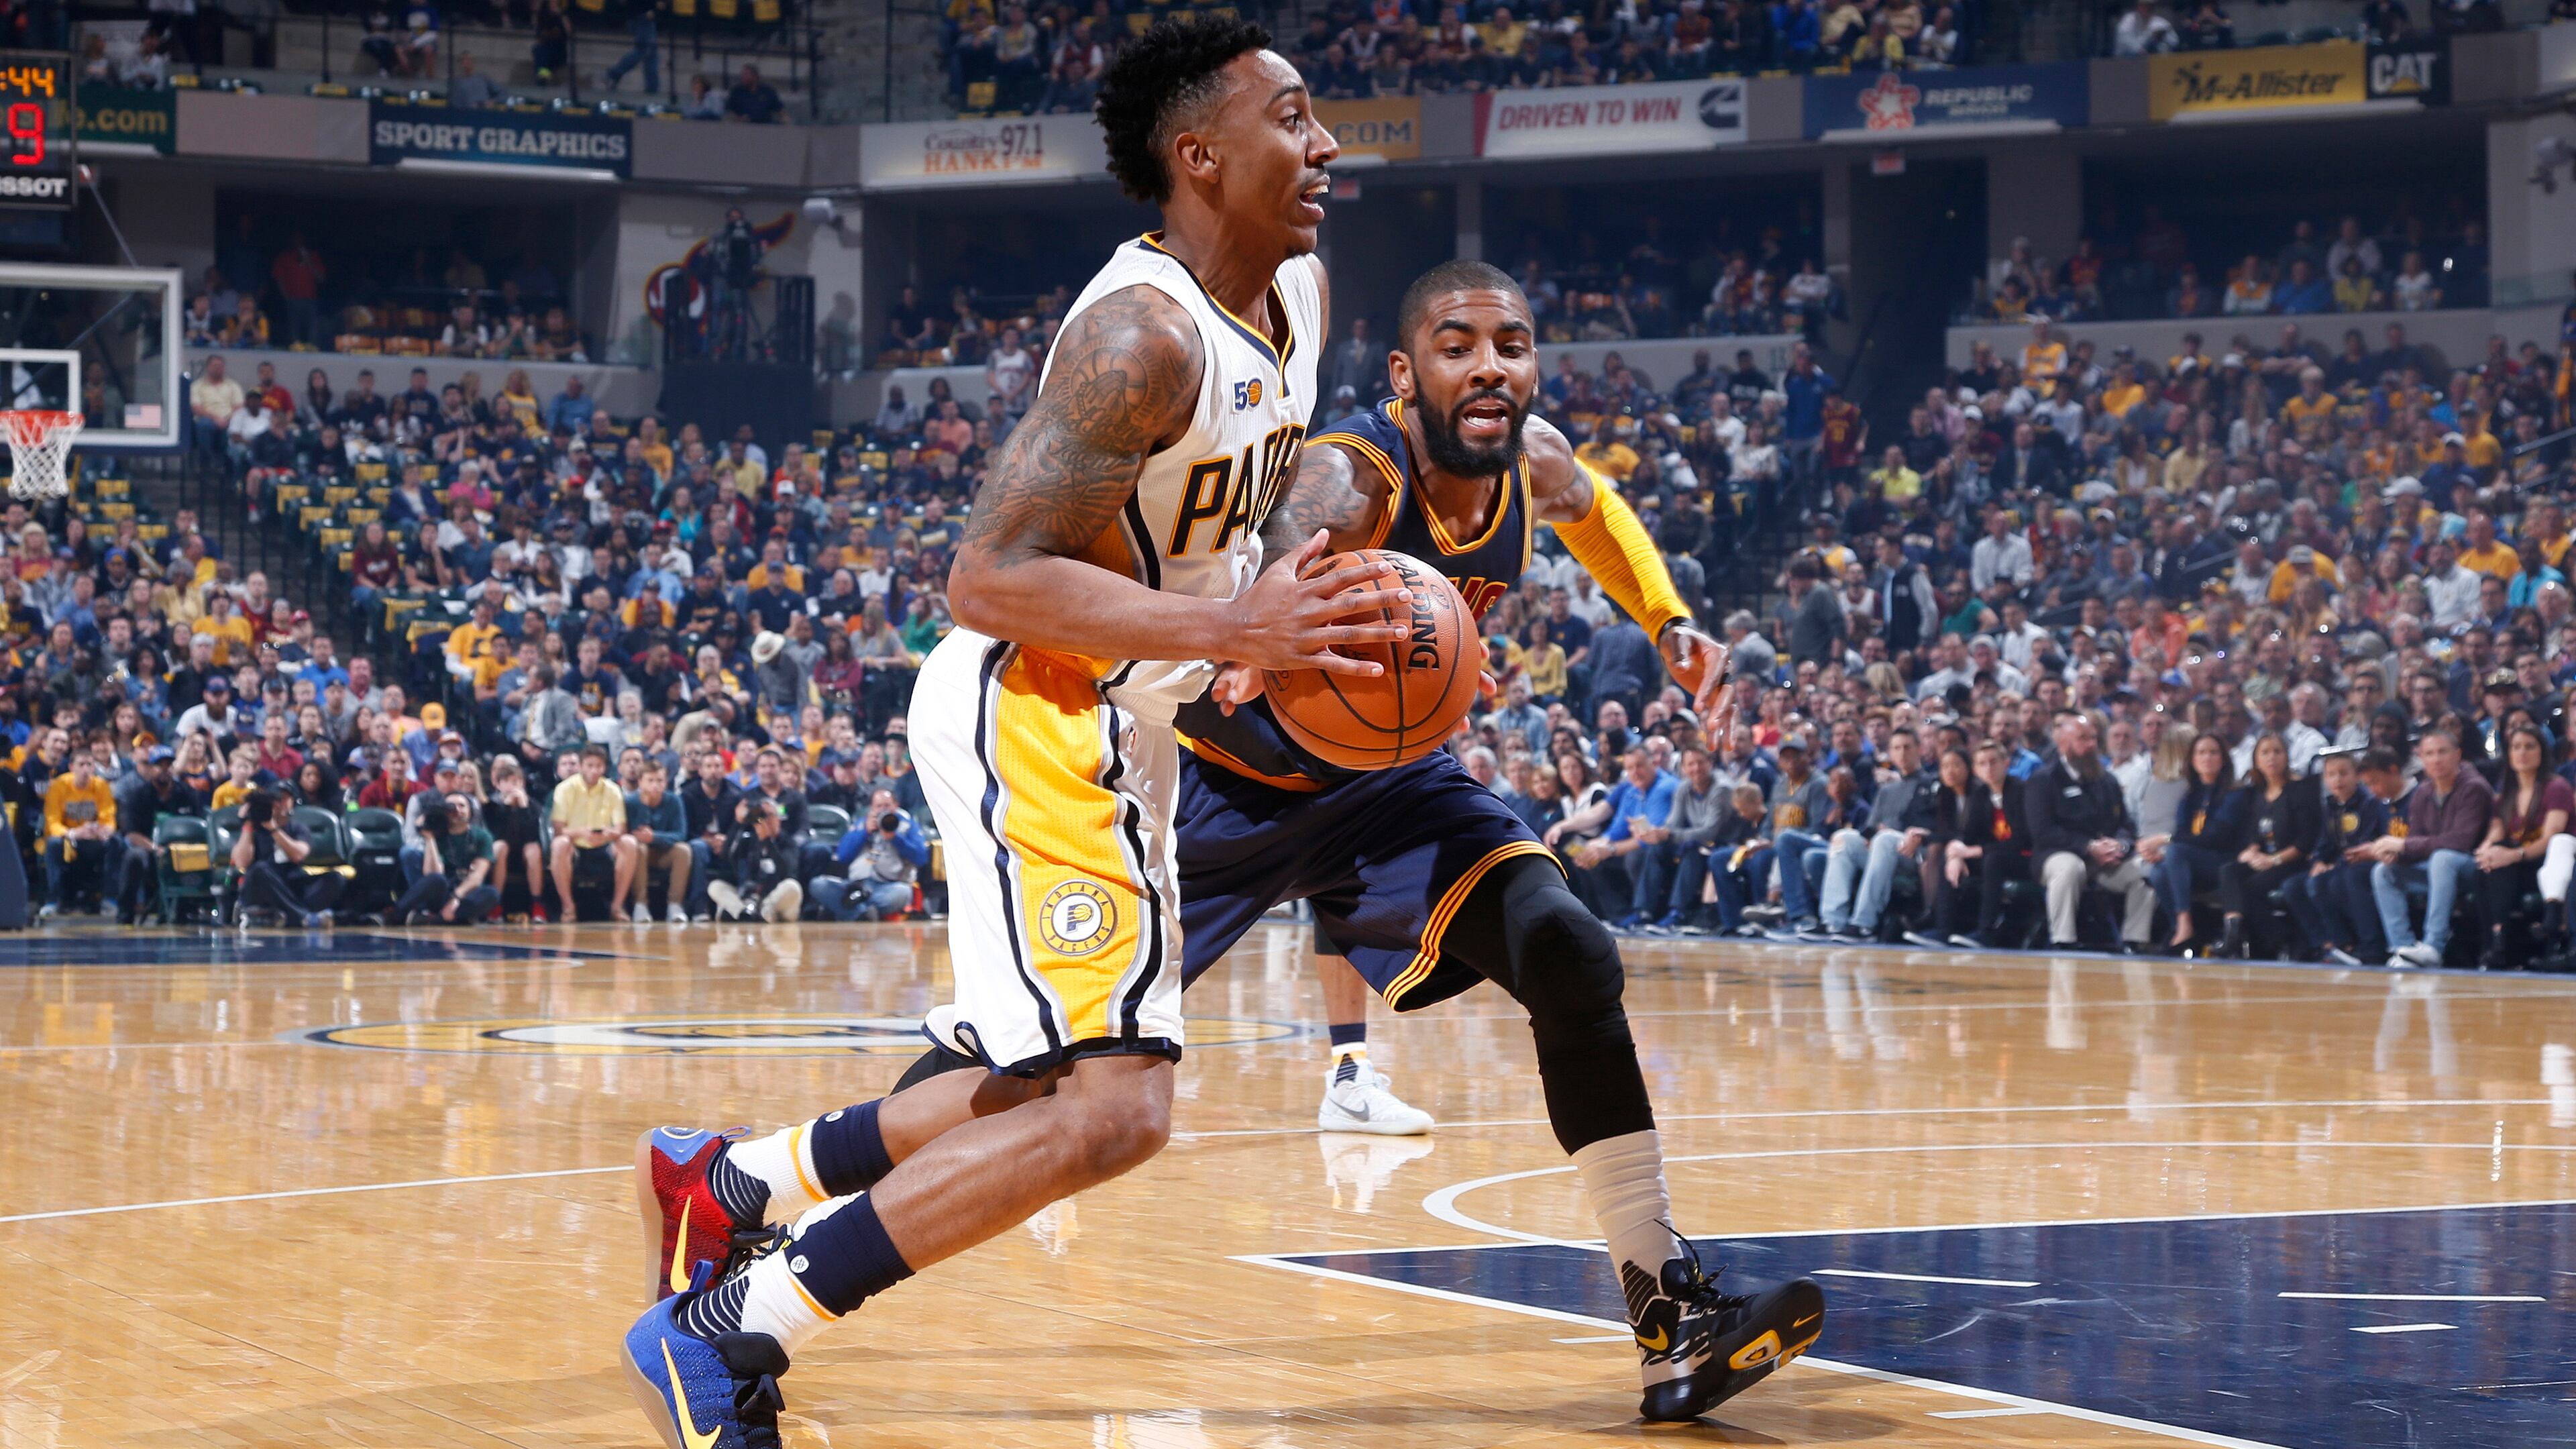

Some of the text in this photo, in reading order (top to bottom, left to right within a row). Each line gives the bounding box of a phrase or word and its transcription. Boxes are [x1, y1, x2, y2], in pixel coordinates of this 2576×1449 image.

[2371, 53, 2437, 94] CAT
[1925, 85, 2033, 107] REPUBLIC
[1499, 97, 1682, 131] DRIVEN TO WIN
[7, 103, 45, 166] 9
[376, 121, 625, 159] SPORT GRAPHICS
[1001, 123, 1043, 156] 97.1
[924, 150, 999, 174] HANK
[1234, 378, 1263, 411] 50
[1041, 884, 1109, 919] INDIANA
